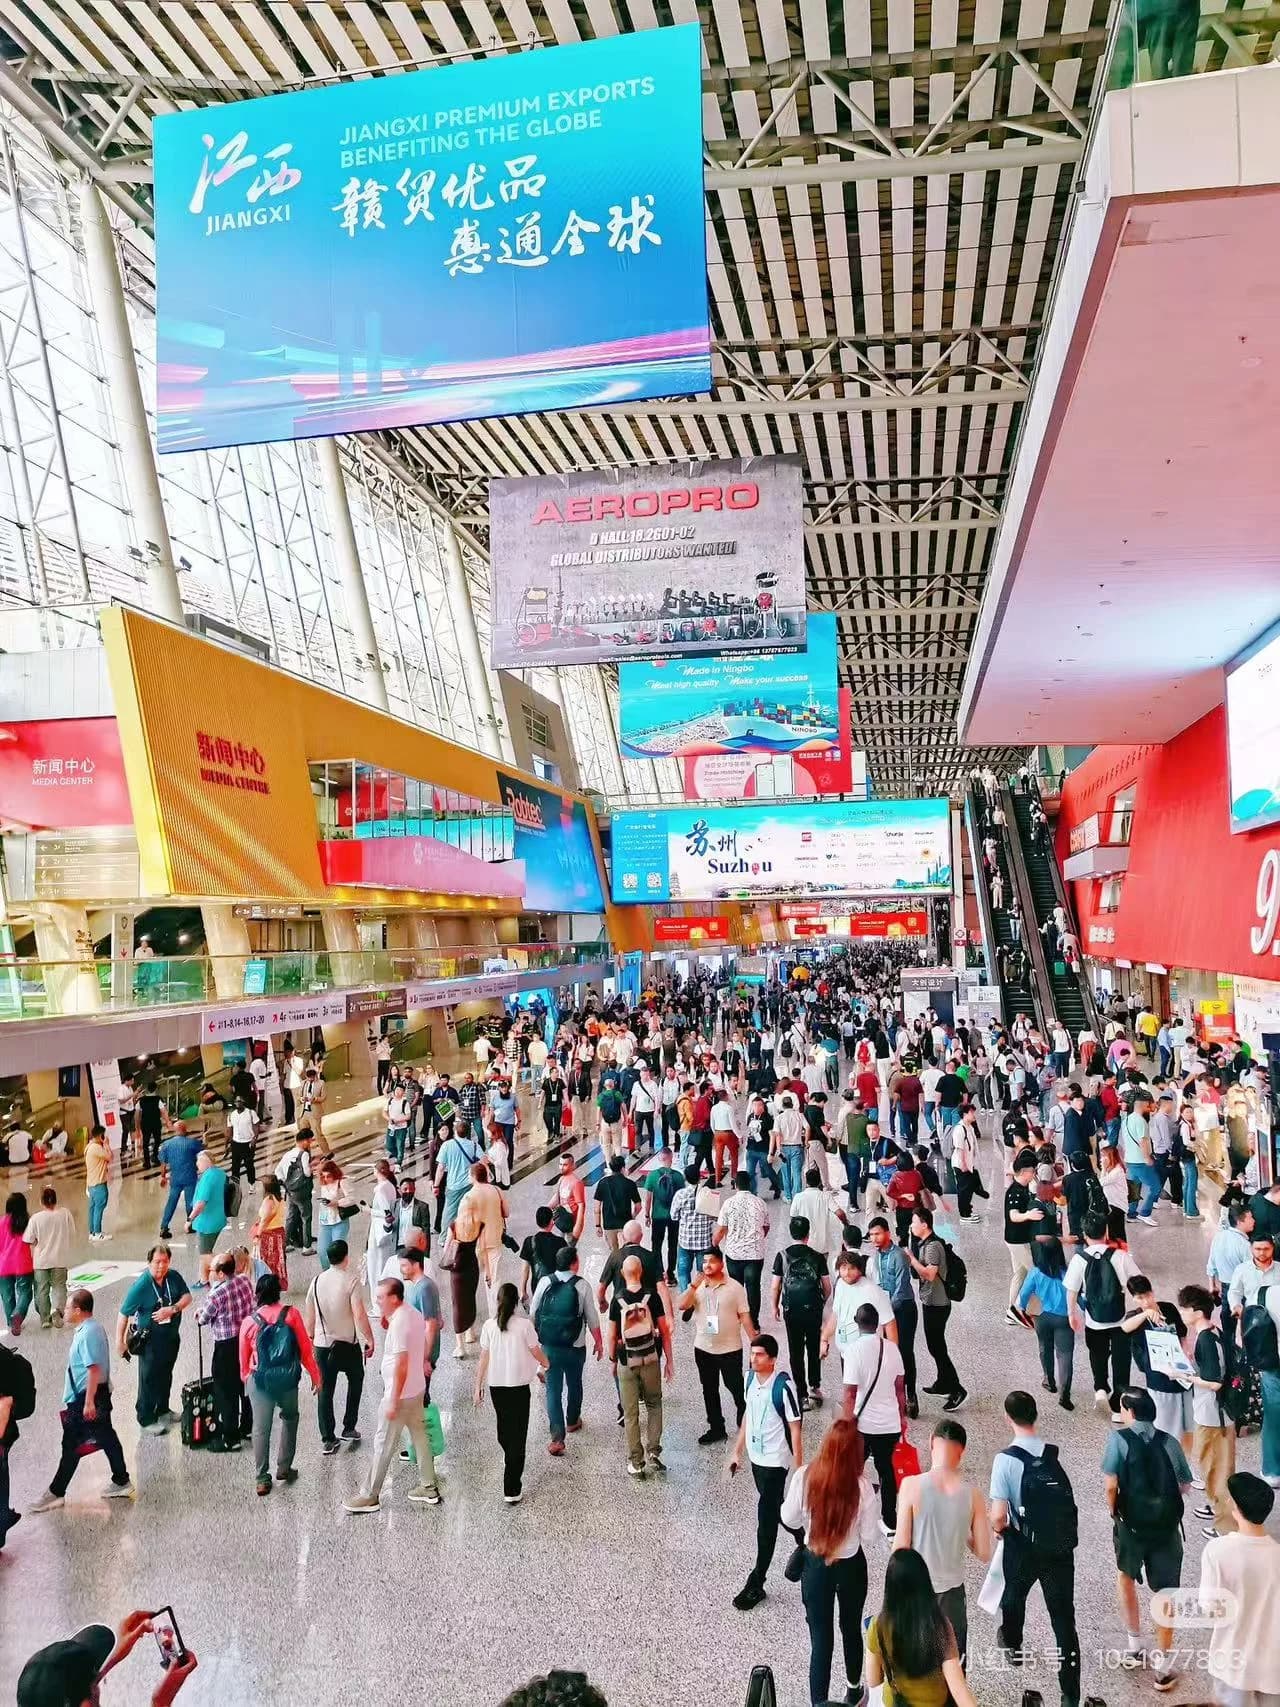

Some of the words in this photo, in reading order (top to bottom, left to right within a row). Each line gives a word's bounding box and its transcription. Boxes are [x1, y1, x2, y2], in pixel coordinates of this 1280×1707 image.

[339, 113, 429, 146] JIANGXI
[435, 97, 541, 130] PREMIUM
[548, 76, 656, 112] EXPORTS
[340, 133, 470, 169] BENEFITING
[475, 124, 520, 149] THE
[526, 109, 603, 142] GLOBE
[189, 130, 302, 215] 江西
[331, 154, 548, 238] 赣贸优品
[205, 208, 290, 236] JIANGXI
[443, 194, 663, 279] 惠通全球
[534, 483, 758, 525] AEROPRO
[550, 549, 594, 568] GLOBAL
[597, 544, 682, 565] DISTRIBUTORS
[682, 540, 737, 558] WANTED!
[677, 665, 710, 676] Made
[723, 665, 754, 674] Ningbo
[755, 676, 773, 684] your
[32, 757, 95, 775] 新闻中心
[196, 730, 266, 775] 新闻中心
[32, 777, 58, 786] MEDIA
[59, 776, 94, 786] CENTER
[200, 767, 235, 788] MEDIA
[685, 819, 737, 857] 苏州
